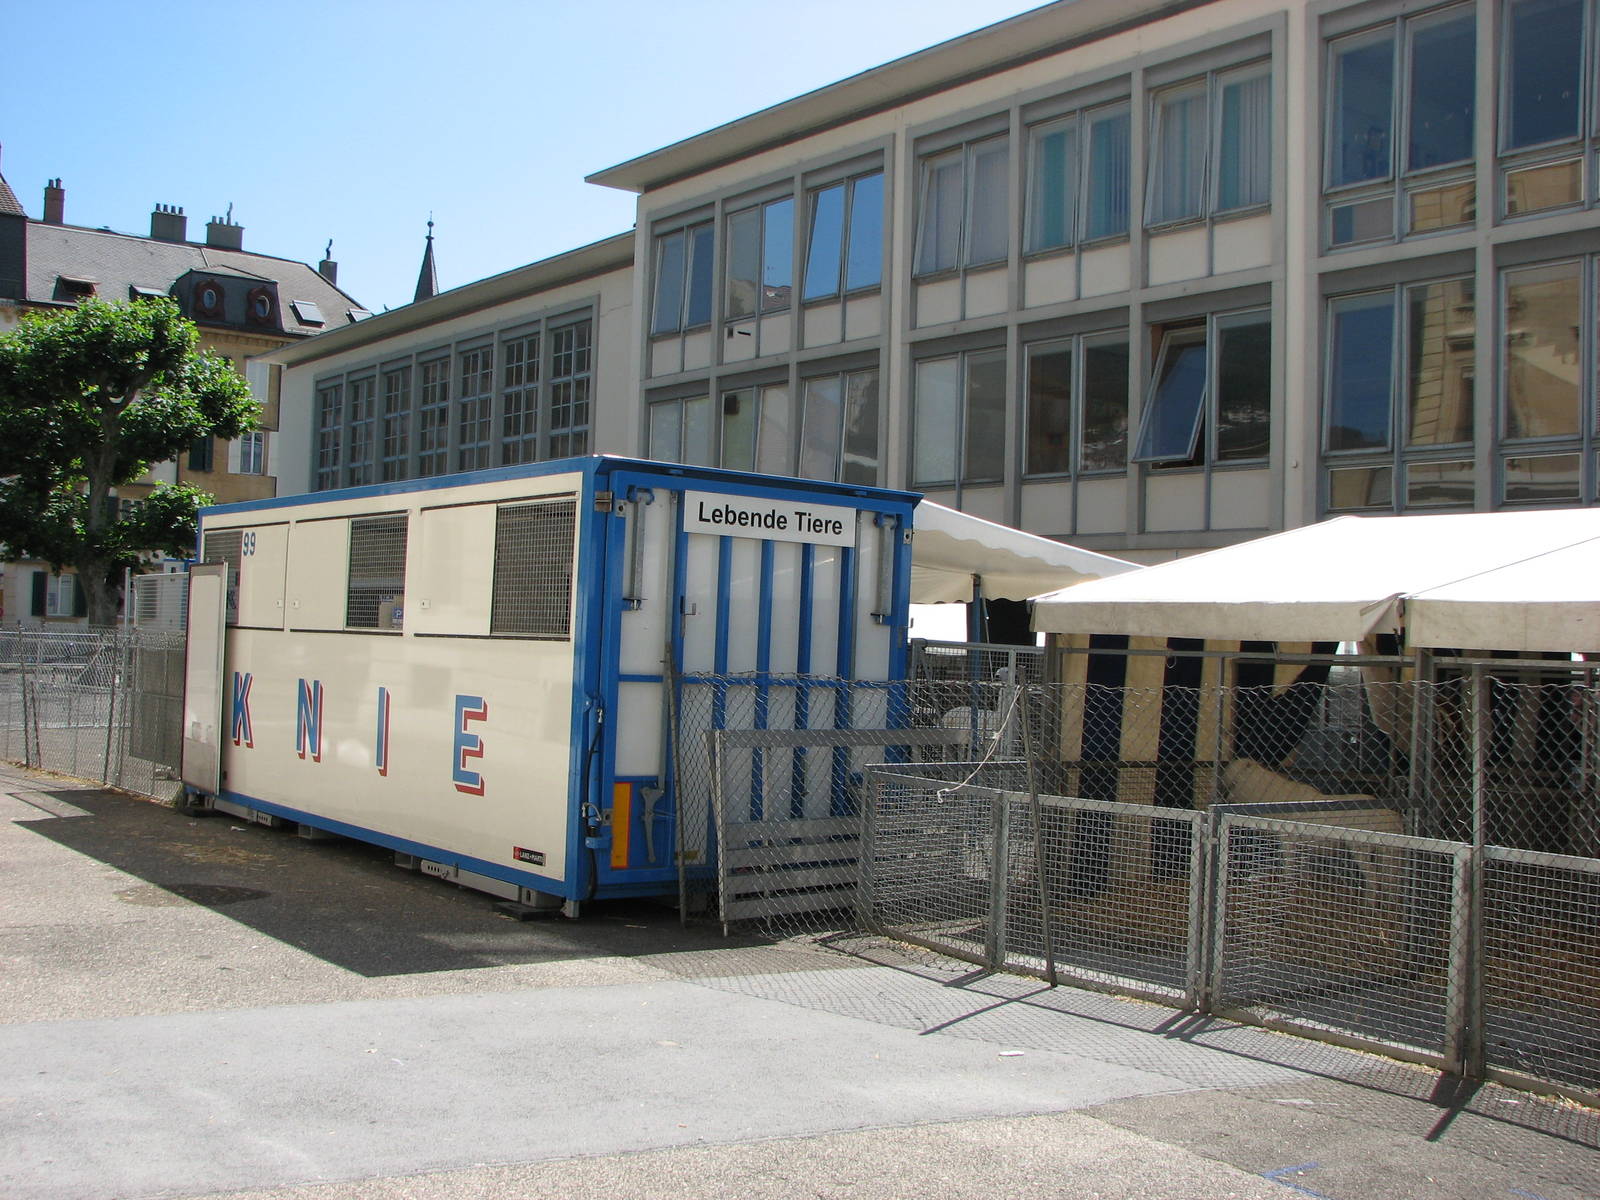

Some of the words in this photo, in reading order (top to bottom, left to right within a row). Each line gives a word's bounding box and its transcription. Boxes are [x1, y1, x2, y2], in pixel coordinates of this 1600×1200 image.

[698, 501, 788, 530] Lebende
[794, 511, 843, 535] Tiere
[243, 532, 256, 556] 99
[232, 672, 487, 797] KNIE
